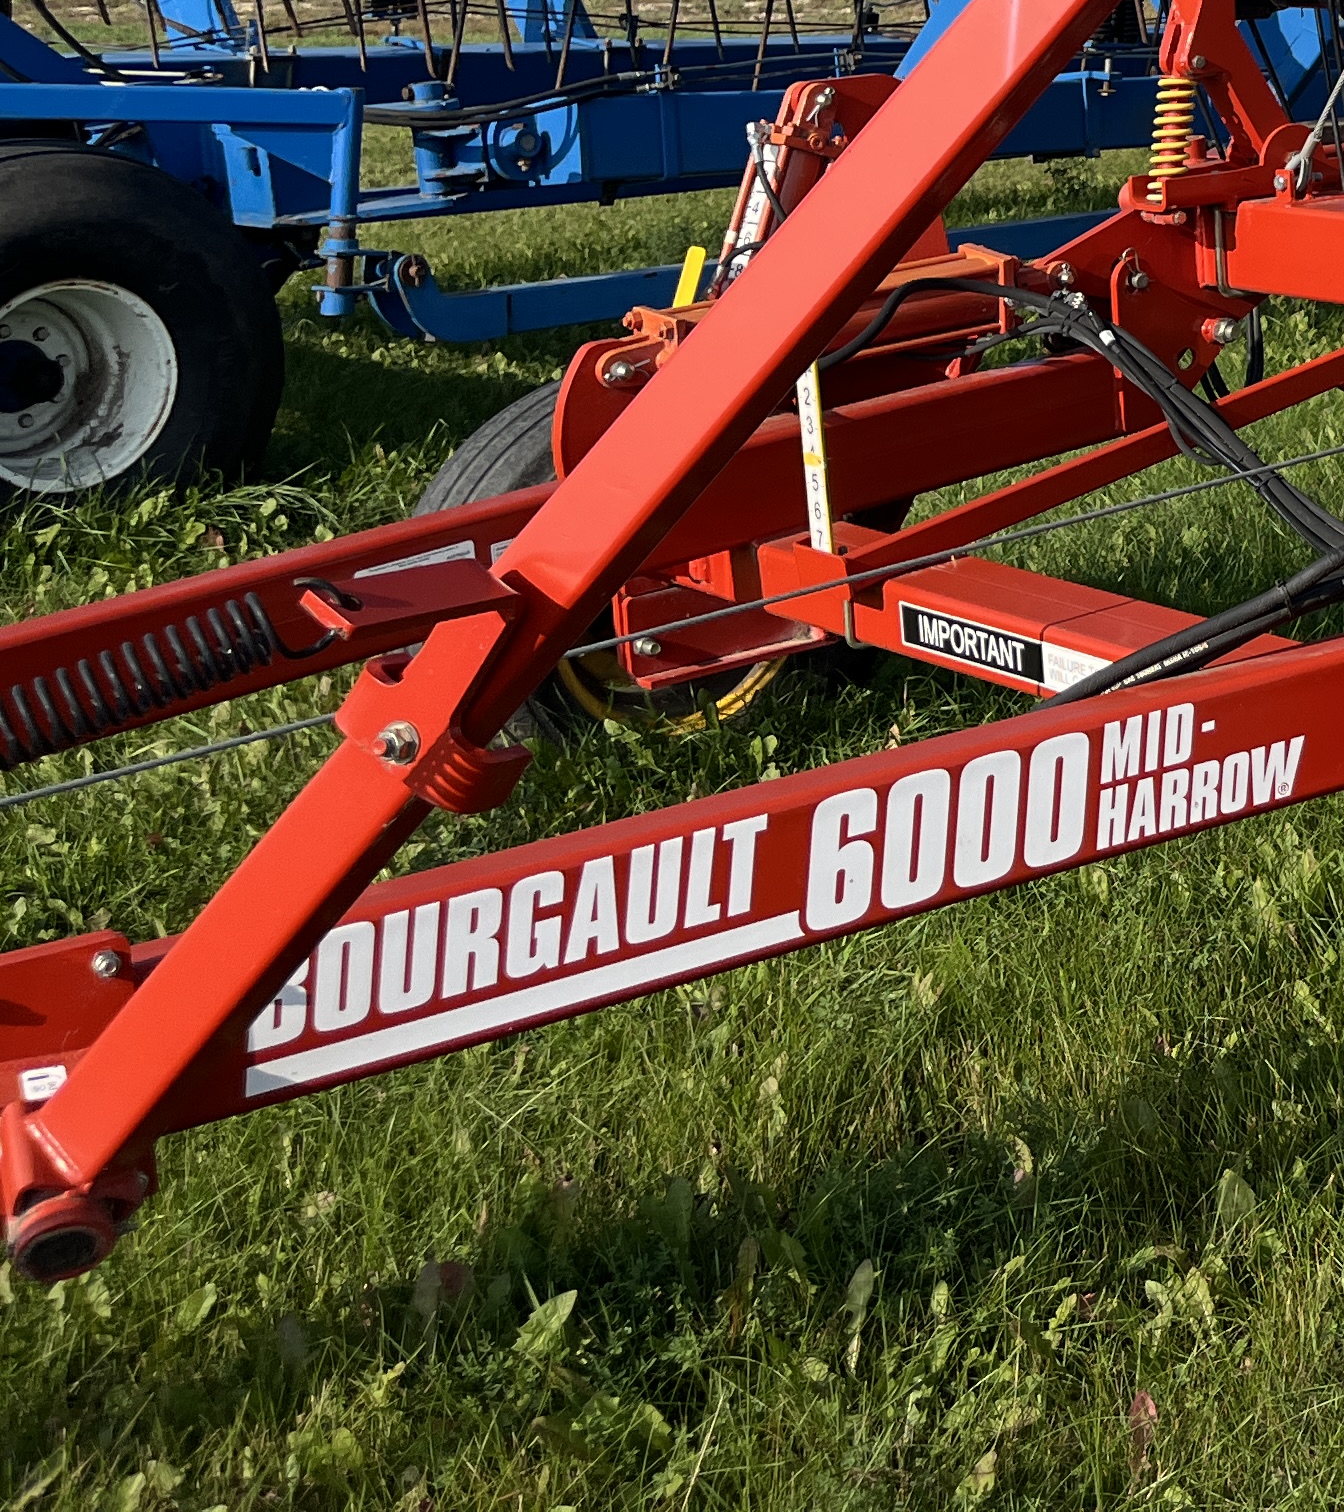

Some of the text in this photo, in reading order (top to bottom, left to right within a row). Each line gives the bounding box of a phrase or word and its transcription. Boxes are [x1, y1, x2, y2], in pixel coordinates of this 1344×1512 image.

[803, 387, 811, 406] 2
[806, 415, 814, 435] 3
[811, 473, 819, 492] 5
[814, 501, 822, 520] 6
[816, 529, 823, 548] 7
[918, 613, 1025, 672] IMPORTANT
[1048, 653, 1087, 676] FAILURE
[1049, 668, 1072, 687] WILL
[1101, 702, 1216, 785] MID-
[247, 732, 1090, 1053] BOURGAULT 6000
